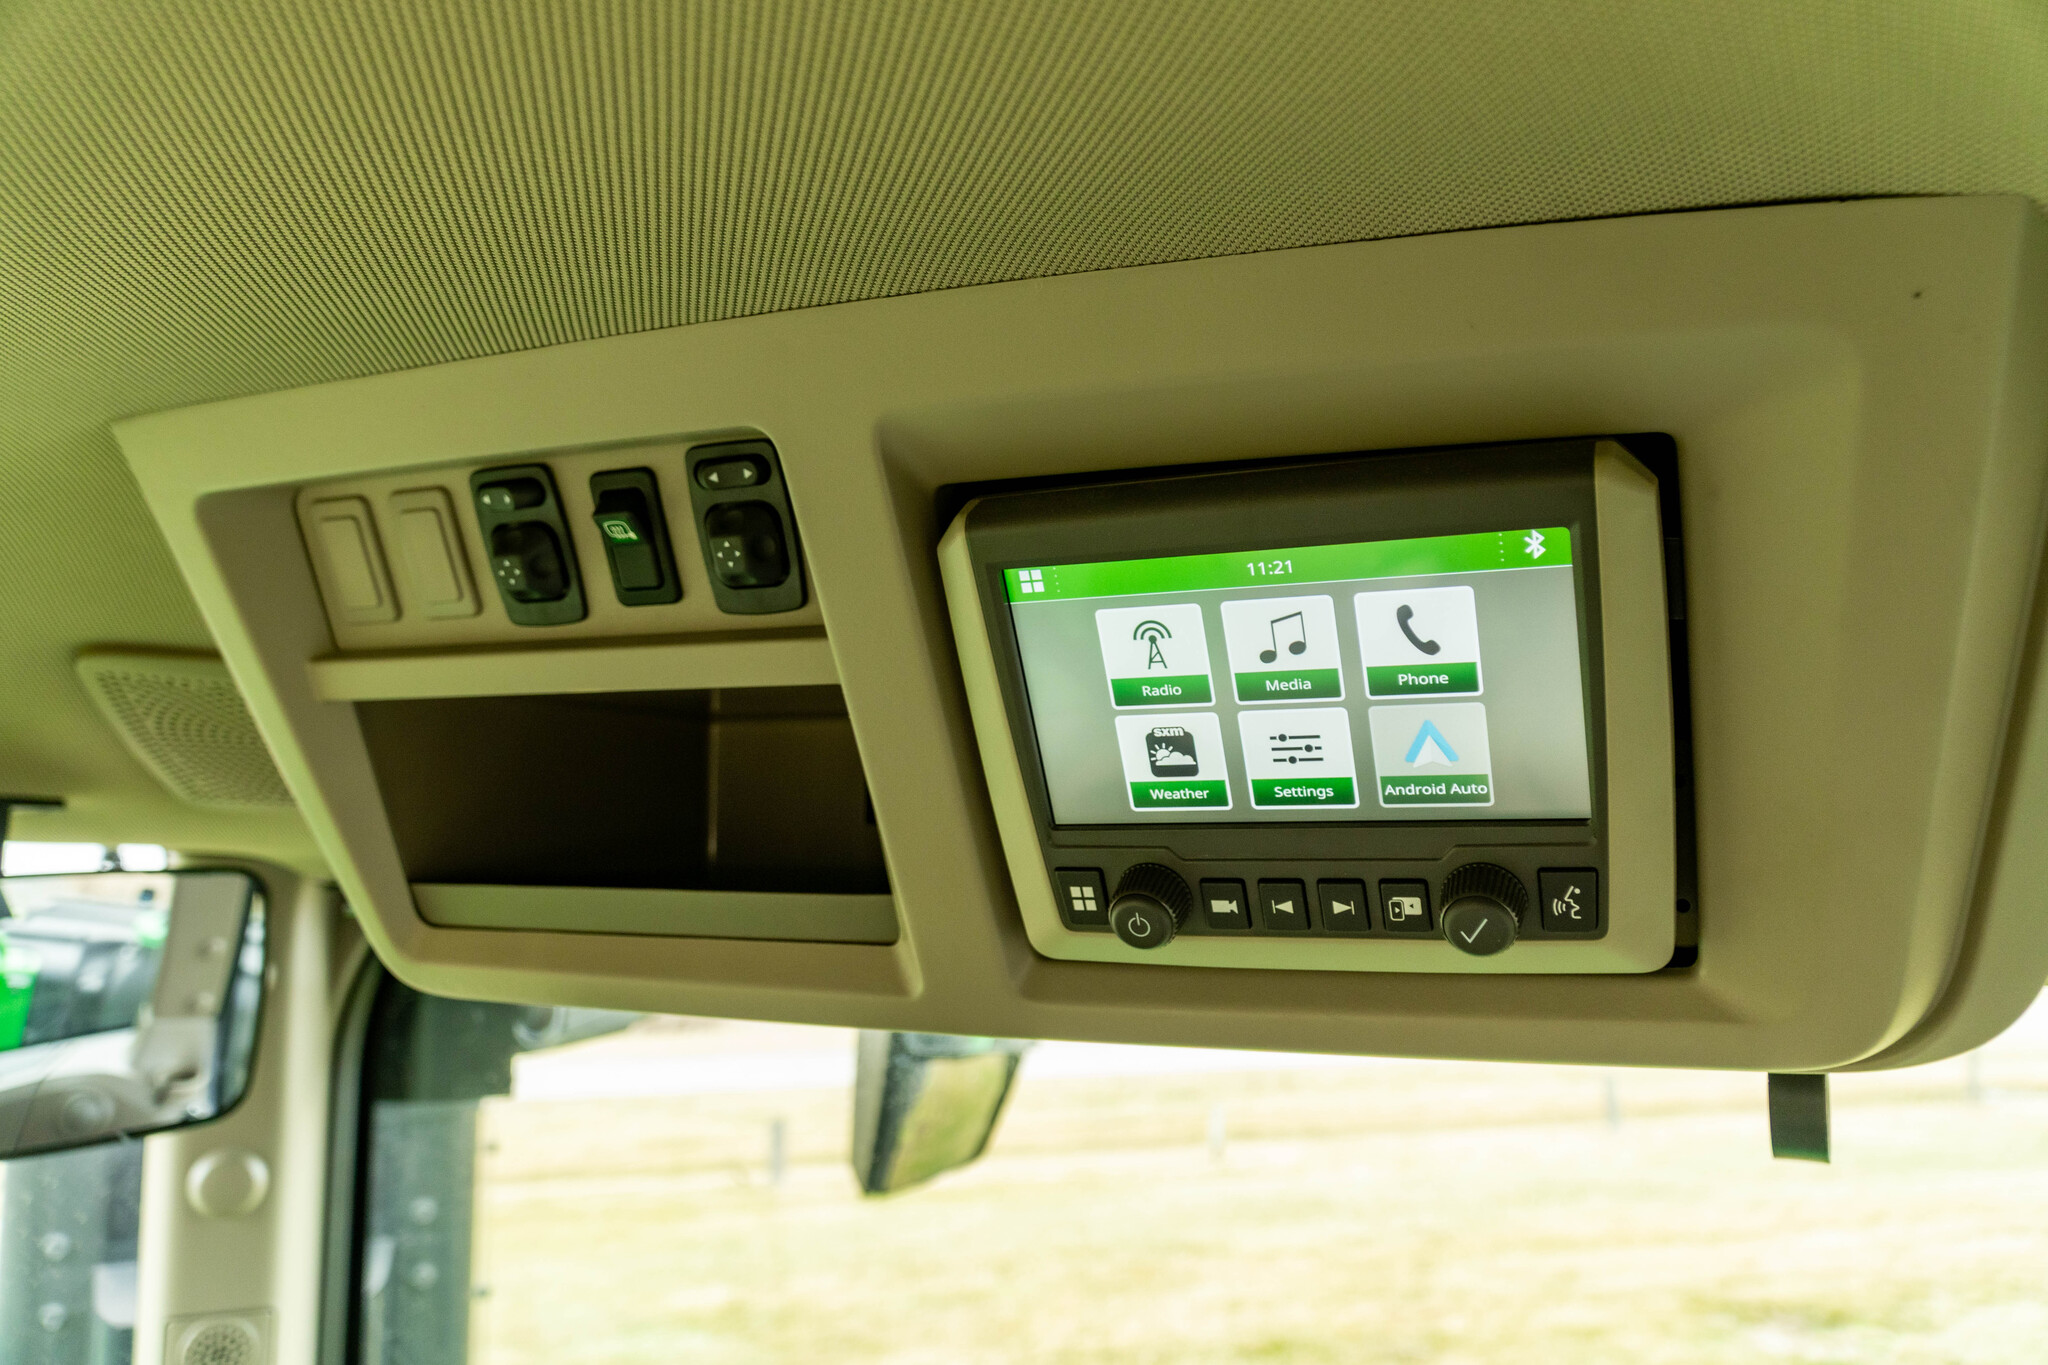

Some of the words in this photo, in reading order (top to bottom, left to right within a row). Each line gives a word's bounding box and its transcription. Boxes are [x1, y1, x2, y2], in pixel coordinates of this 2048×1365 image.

[1246, 559, 1294, 576] 11:21
[1265, 676, 1313, 692] Media
[1397, 671, 1450, 688] Phone
[1141, 683, 1183, 699] Radio
[1153, 726, 1185, 738] sxm
[1149, 785, 1210, 801] Weather
[1273, 782, 1335, 801] Settings
[1384, 781, 1446, 798] Android
[1450, 780, 1488, 797] Auto
